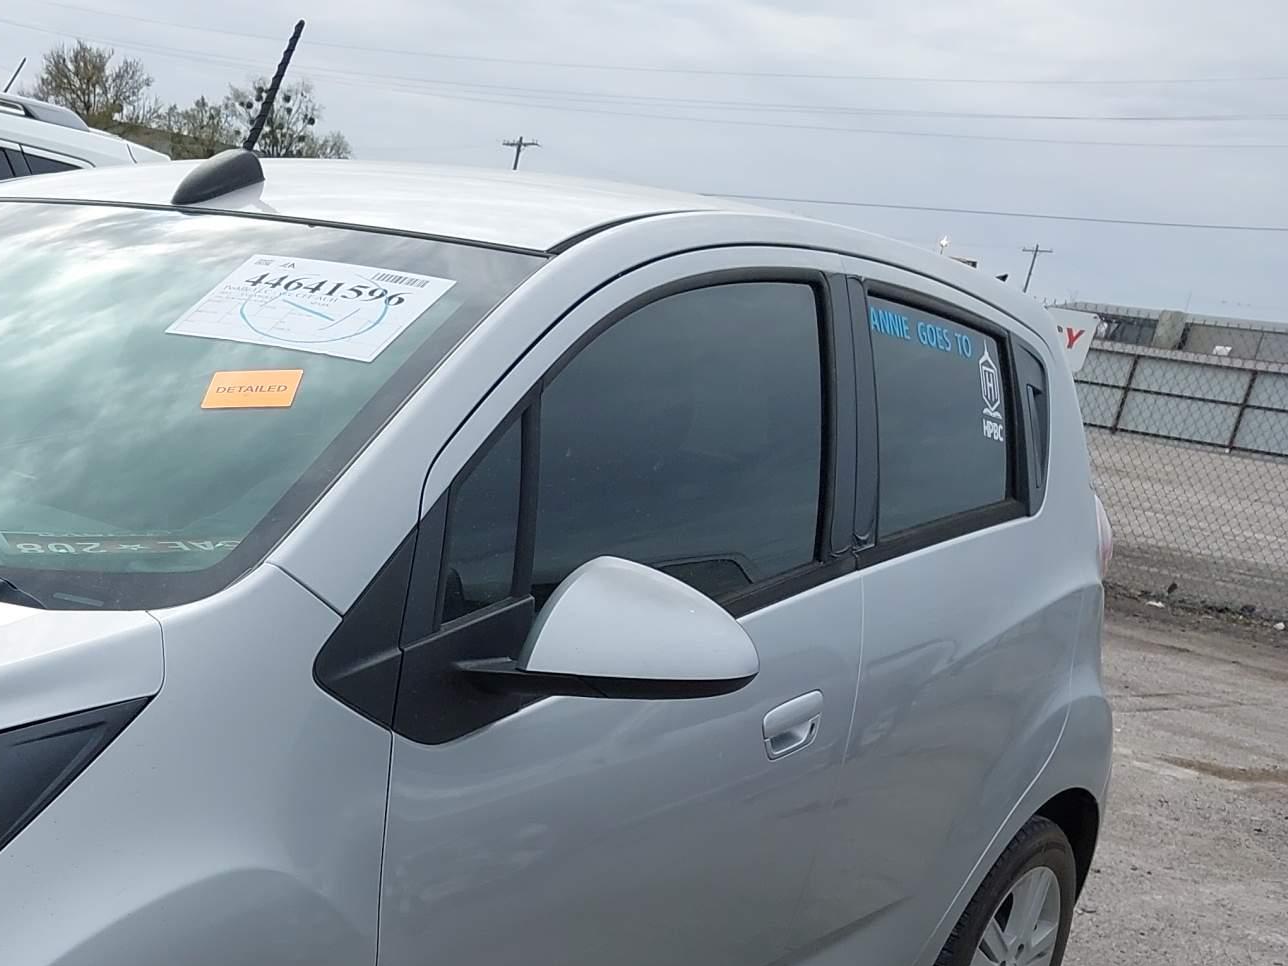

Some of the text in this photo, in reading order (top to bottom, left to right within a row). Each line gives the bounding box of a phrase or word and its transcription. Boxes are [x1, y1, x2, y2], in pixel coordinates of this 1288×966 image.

[245, 272, 408, 307] 44641596
[869, 306, 972, 358] ANNIE GOES TO
[215, 384, 288, 394] DETAILED
[982, 418, 1004, 442] HPBC
